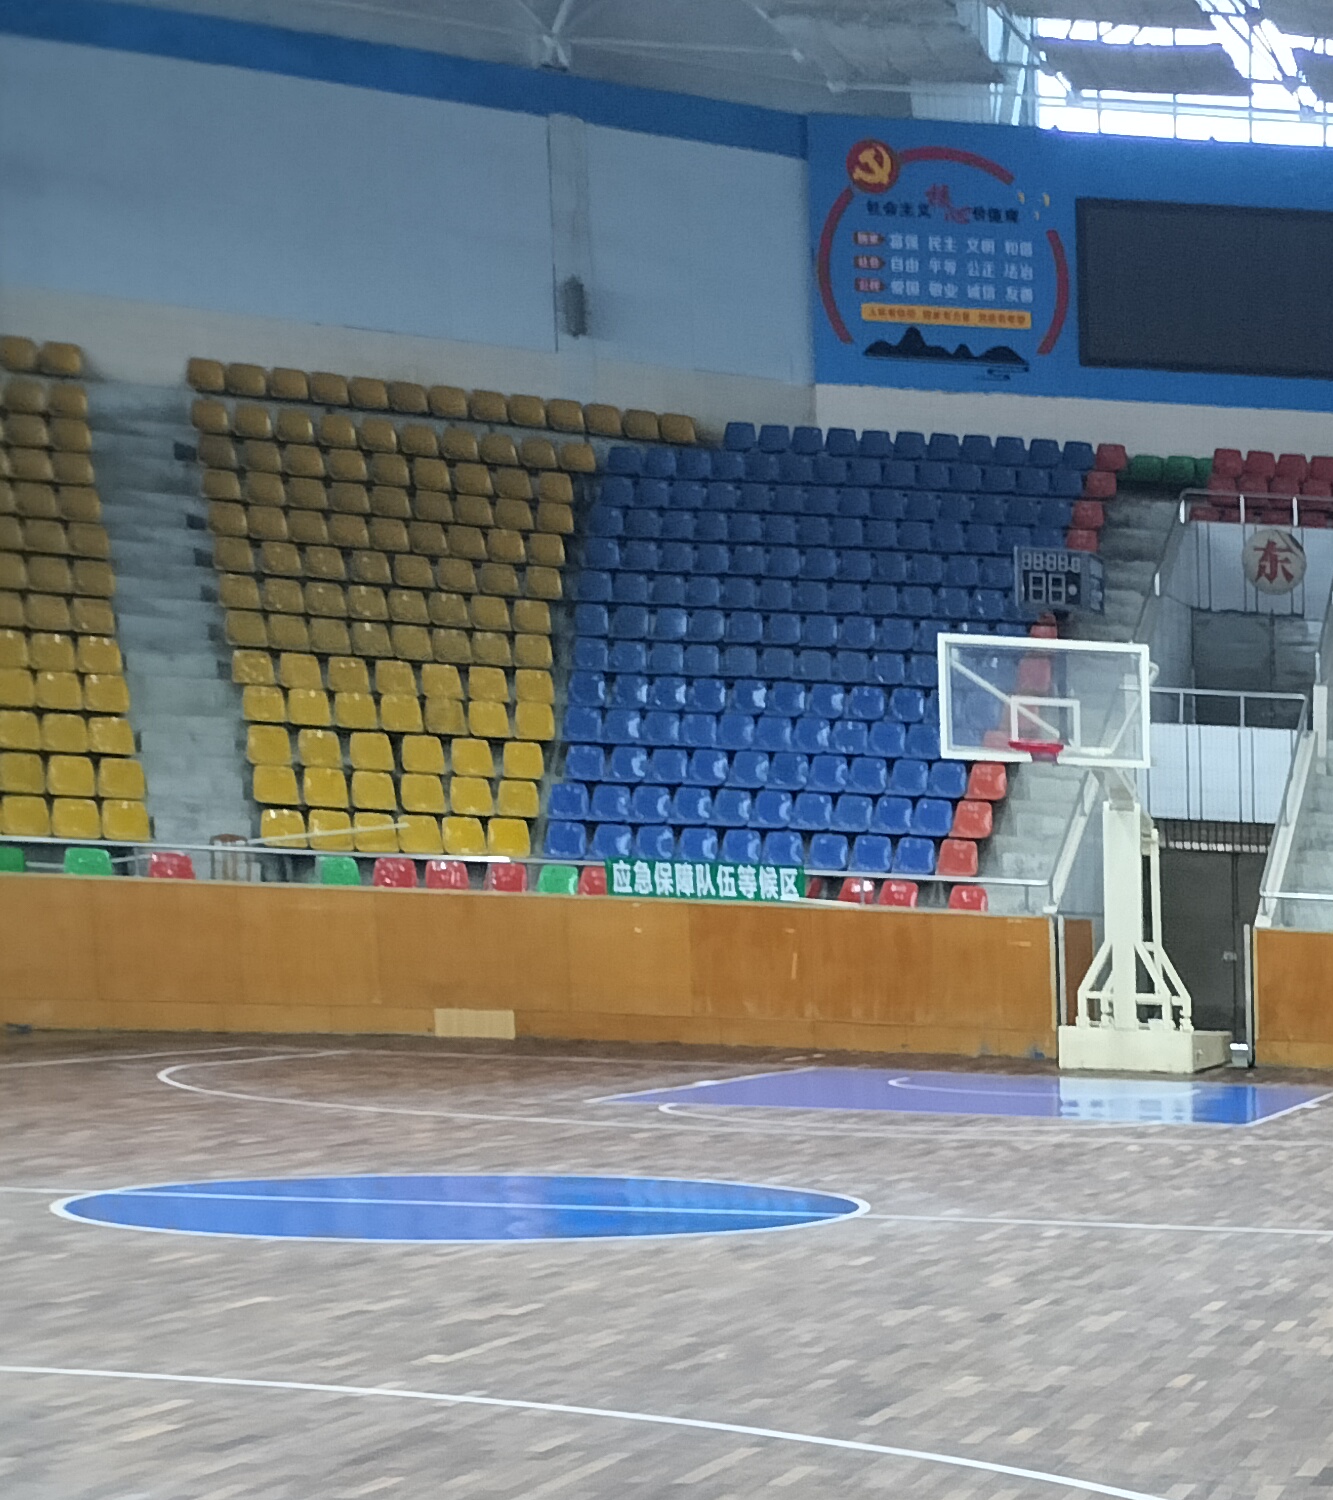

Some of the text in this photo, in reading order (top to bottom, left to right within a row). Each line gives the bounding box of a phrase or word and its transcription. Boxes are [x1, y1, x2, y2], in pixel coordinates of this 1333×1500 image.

[891, 256, 919, 273] 自由
[1253, 539, 1295, 584] 东
[612, 860, 800, 900] 应急保障队伍等候区
